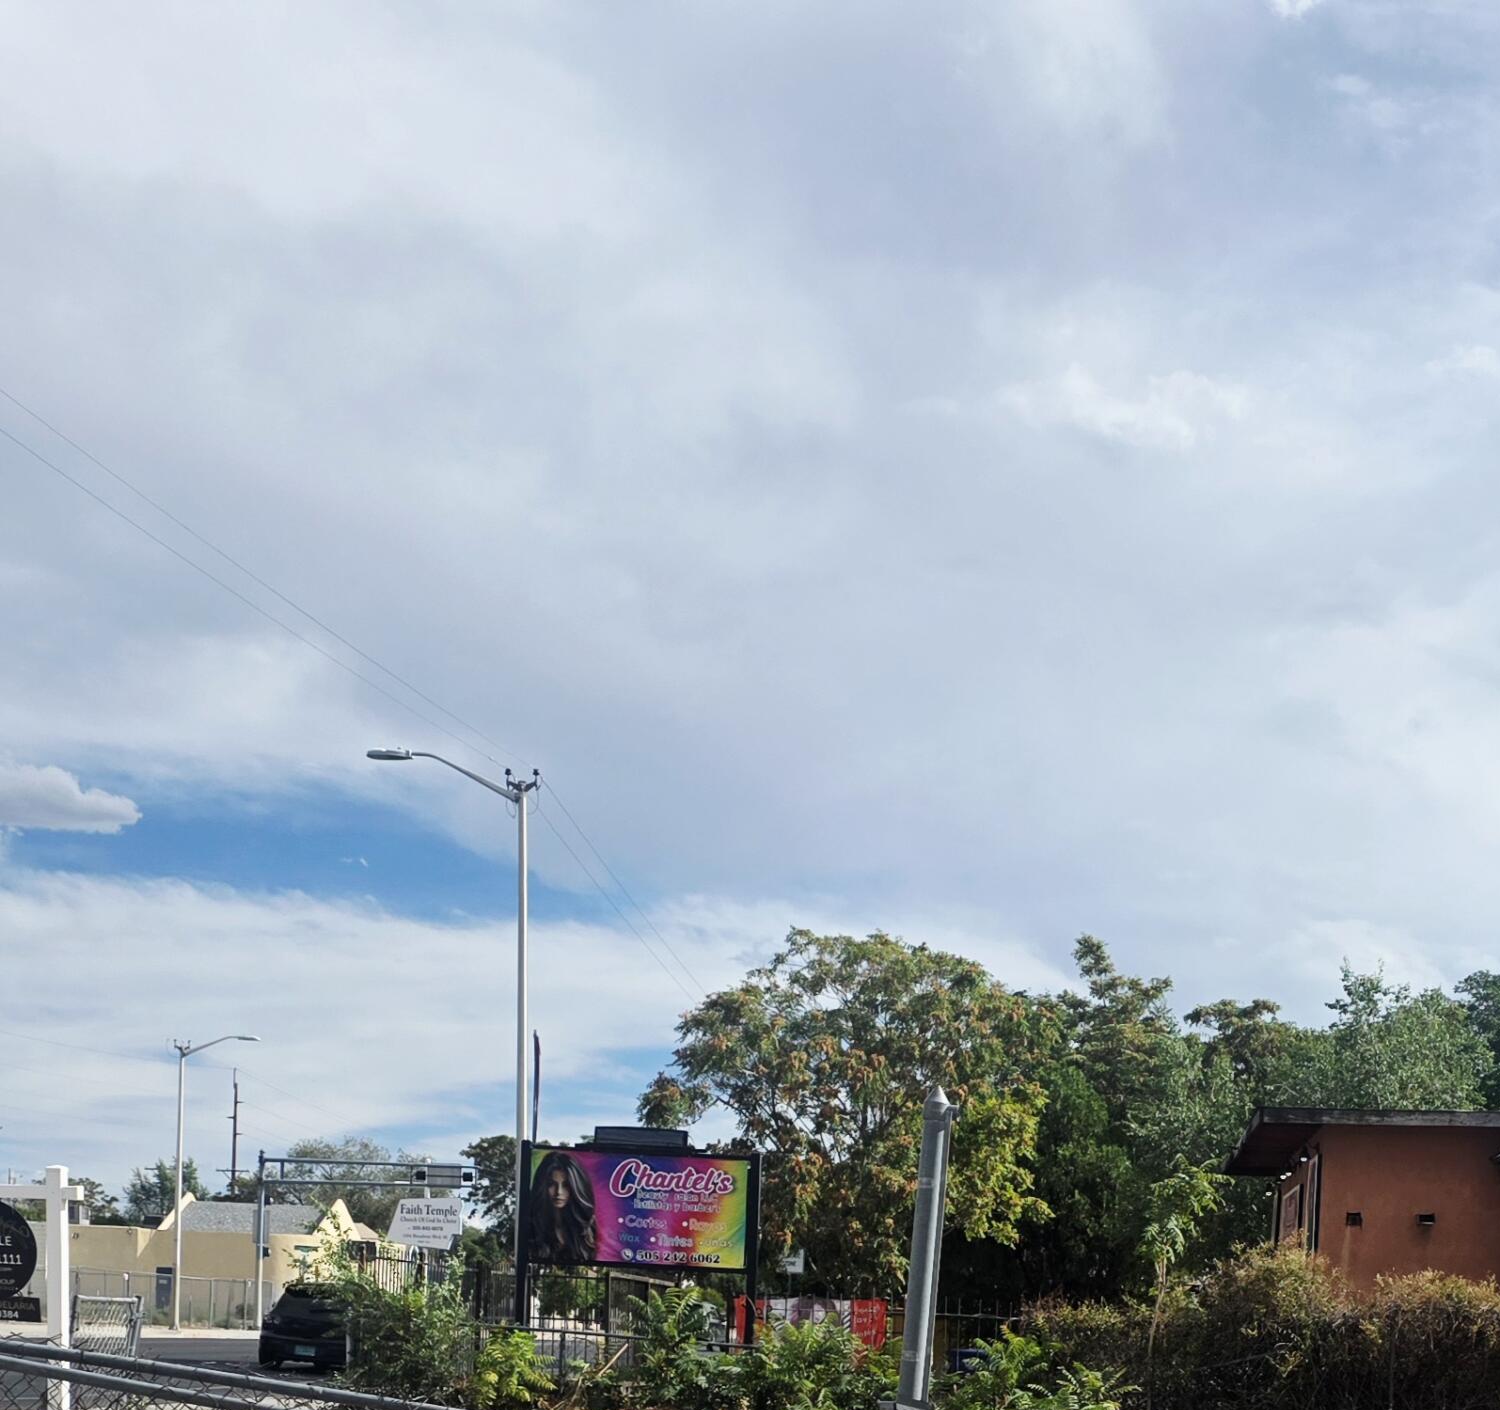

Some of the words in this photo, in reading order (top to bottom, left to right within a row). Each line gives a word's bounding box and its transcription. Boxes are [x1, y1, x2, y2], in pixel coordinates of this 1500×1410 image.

[610, 1158, 734, 1197] Chantel's
[400, 1203, 423, 1215] Faith
[424, 1204, 458, 1217] Temple
[0, 1253, 22, 1265] 111
[636, 1250, 659, 1261] 505
[689, 1252, 721, 1264] 6062
[0, 1310, 19, 1319] 384
